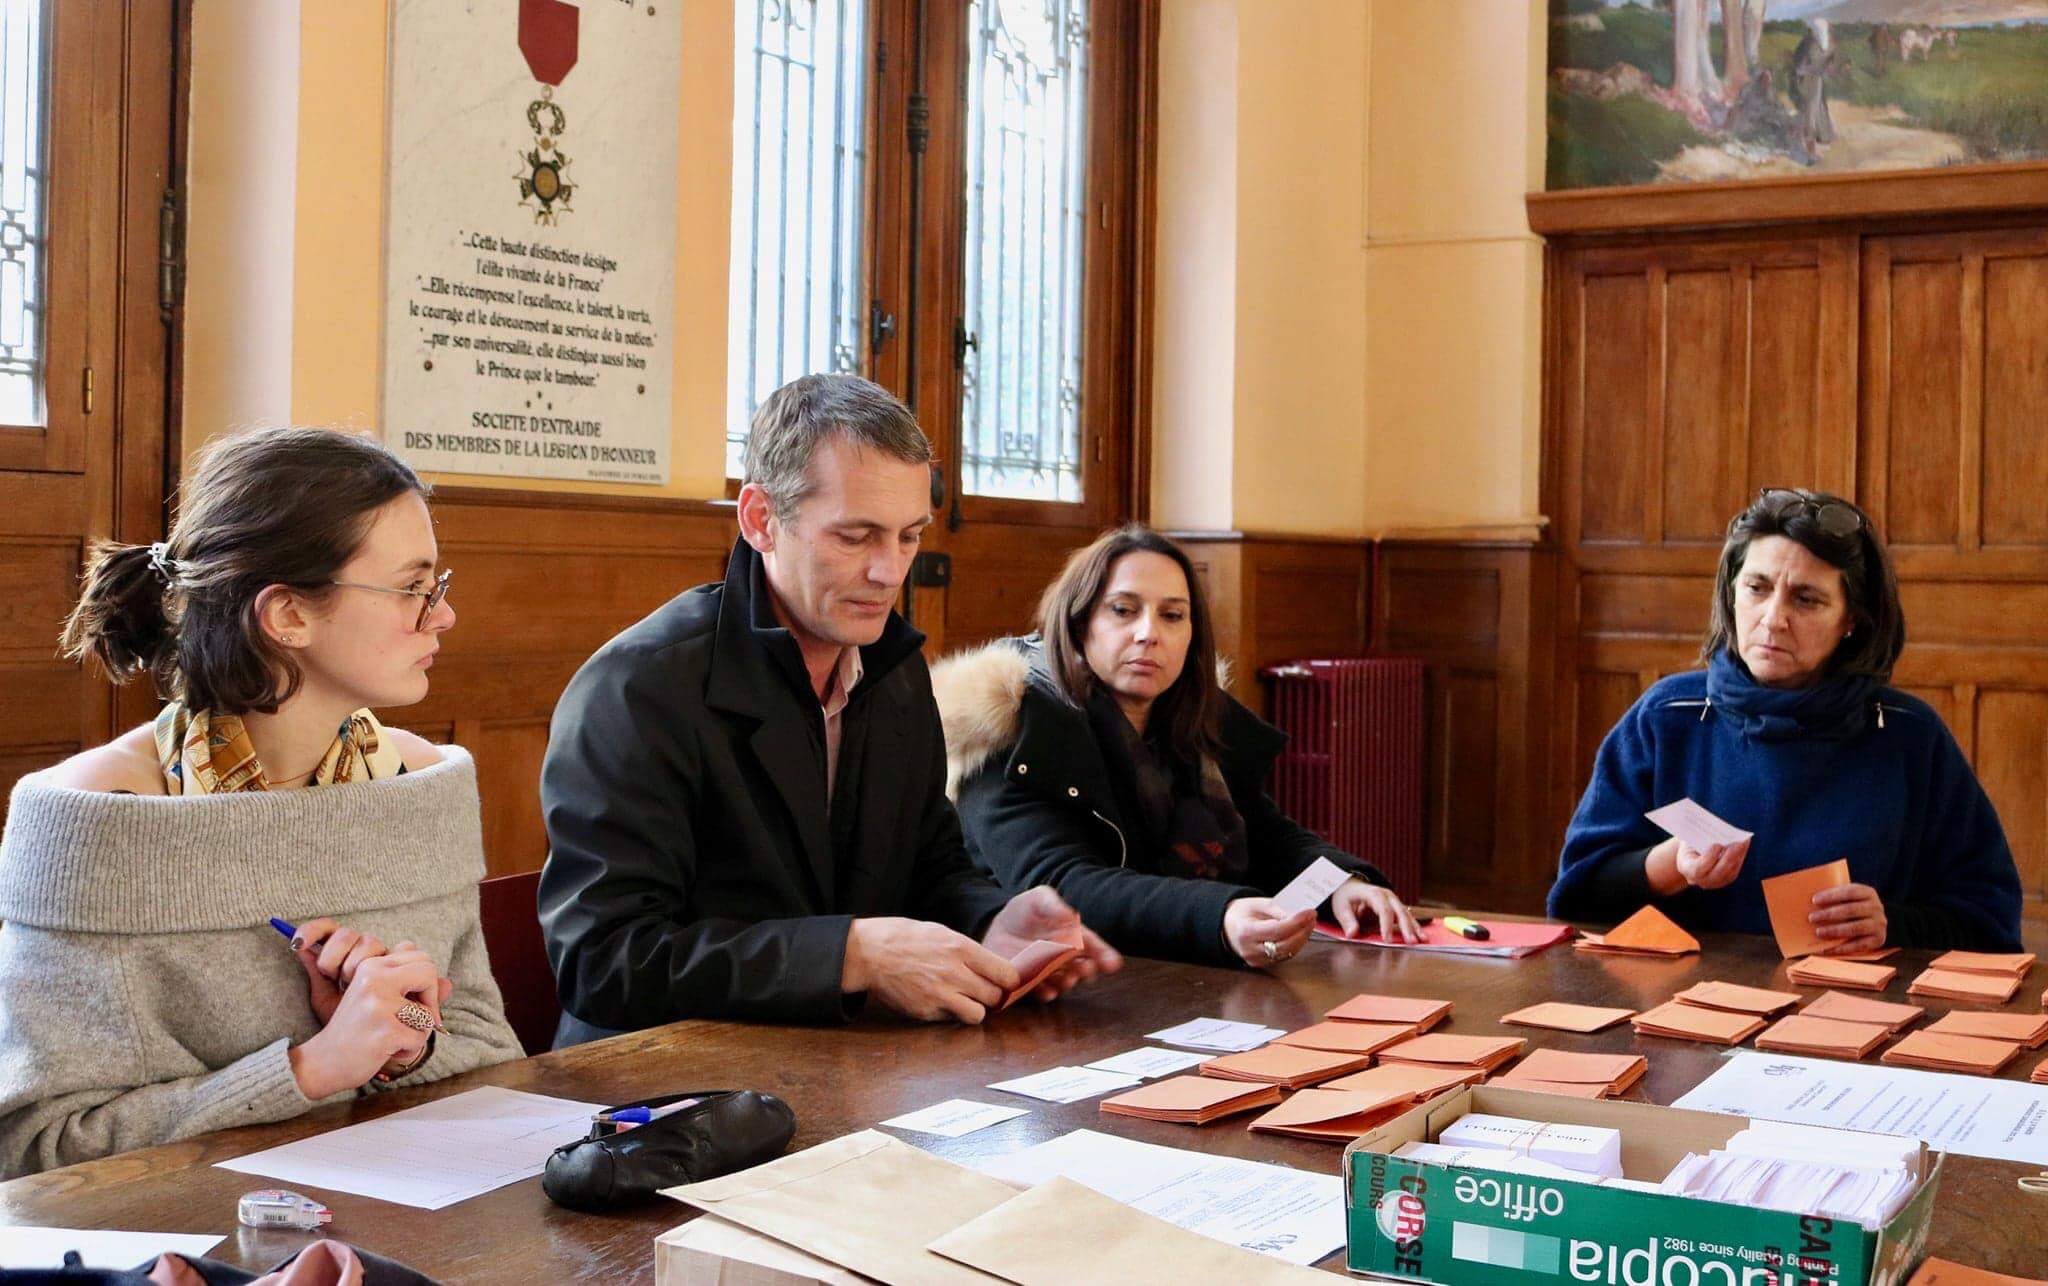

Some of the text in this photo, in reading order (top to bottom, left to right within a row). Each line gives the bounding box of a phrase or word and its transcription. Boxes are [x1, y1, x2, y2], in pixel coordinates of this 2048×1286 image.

[500, 237, 527, 256] haute
[529, 243, 580, 265] distinction
[505, 264, 541, 284] vivante
[543, 270, 555, 286] de
[557, 272, 566, 287] la
[452, 281, 515, 305] récompense
[576, 298, 585, 315] le
[616, 304, 625, 320] la
[409, 299, 419, 316] le
[421, 305, 464, 327] courage
[466, 308, 477, 325] et
[478, 309, 488, 325] le
[551, 323, 563, 336] au
[565, 323, 600, 341] service
[601, 326, 613, 343] de
[614, 328, 623, 343] la
[452, 336, 472, 350] son
[536, 342, 554, 360] elle
[556, 345, 599, 367] distingue
[601, 353, 625, 367] aussi
[626, 353, 647, 371] bien
[476, 359, 486, 376] le
[487, 360, 521, 380] Prince
[523, 368, 542, 385] que
[543, 367, 553, 383] le
[530, 416, 602, 438] D'ENTRAIDE
[405, 431, 434, 451] DES
[436, 433, 501, 455] MEMBRES
[504, 439, 522, 457] DE
[524, 441, 541, 458] LA
[590, 445, 658, 465] D'HONNEUR
[1454, 1175, 1565, 1222] office
[1394, 1175, 1428, 1276] CORSE
[1663, 1236, 1695, 1253] 1982
[1699, 1242, 1735, 1258] since
[1737, 1245, 1784, 1266] Quality
[1786, 1252, 1840, 1277] Printing
